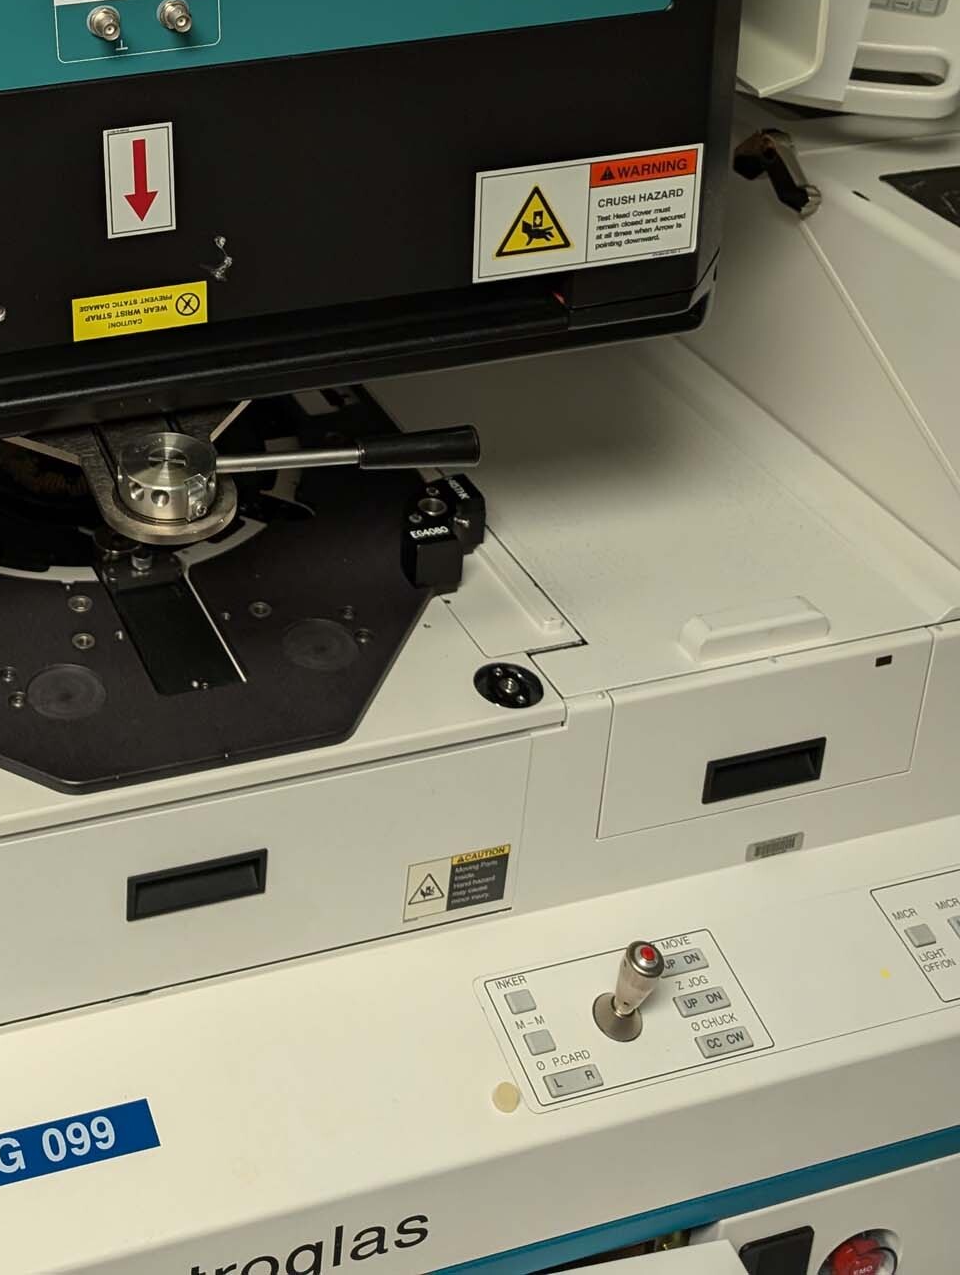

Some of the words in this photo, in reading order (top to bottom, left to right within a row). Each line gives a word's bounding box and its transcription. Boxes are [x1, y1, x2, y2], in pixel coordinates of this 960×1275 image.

[617, 158, 688, 179] WARNING
[597, 194, 636, 208] CRUSH
[638, 188, 684, 203] HAZARD
[597, 214, 611, 222] Test
[613, 211, 631, 220] Head
[632, 209, 652, 217] Cover
[653, 206, 671, 214] must
[596, 223, 620, 231] remain
[621, 219, 644, 228] closed
[645, 216, 658, 224] and
[659, 213, 686, 222] secured
[634, 226, 653, 234] when
[595, 238, 623, 250] pointing
[112, 298, 139, 308] STATIC
[140, 293, 173, 304] PREVENT
[79, 302, 111, 313] DAMAGE
[115, 309, 141, 318] WRIST
[143, 305, 168, 314] WEAR
[85, 312, 113, 323] STRAP
[107, 317, 143, 329] CAUTION!
[464, 846, 505, 861] CAUTION
[660, 936, 691, 950] MOVE
[683, 952, 701, 965] DN
[495, 975, 528, 989] INKER
[675, 980, 685, 991] Z
[688, 974, 709, 988] JOG
[683, 998, 699, 1009] UP
[705, 991, 723, 1004] DN
[700, 1012, 739, 1030] CHUCK
[706, 1037, 723, 1049] CC
[725, 1031, 745, 1045] CW
[553, 1078, 564, 1088] L
[584, 1069, 596, 1081] R
[41, 1116, 116, 1162] 099
[190, 1214, 430, 1275] oglas
